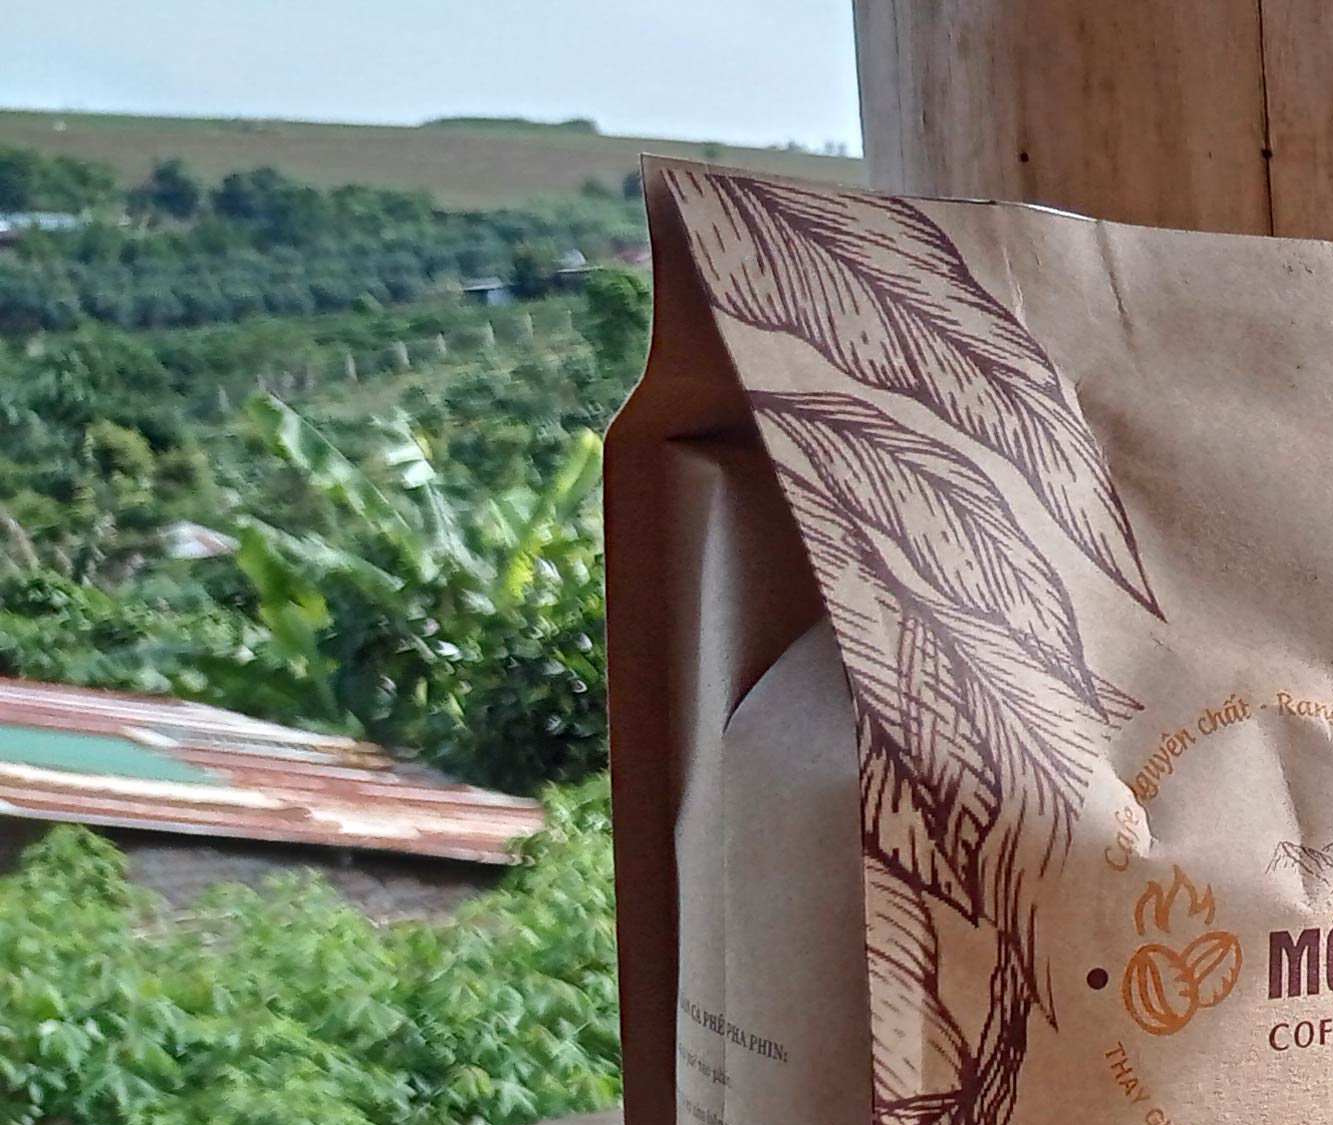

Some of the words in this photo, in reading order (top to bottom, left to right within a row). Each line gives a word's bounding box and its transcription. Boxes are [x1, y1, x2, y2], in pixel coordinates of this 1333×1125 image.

[1197, 694, 1252, 736] chất
[726, 1022, 747, 1048] PHA
[749, 1033, 788, 1063] PHIN:
[1105, 1041, 1150, 1105] THAY
